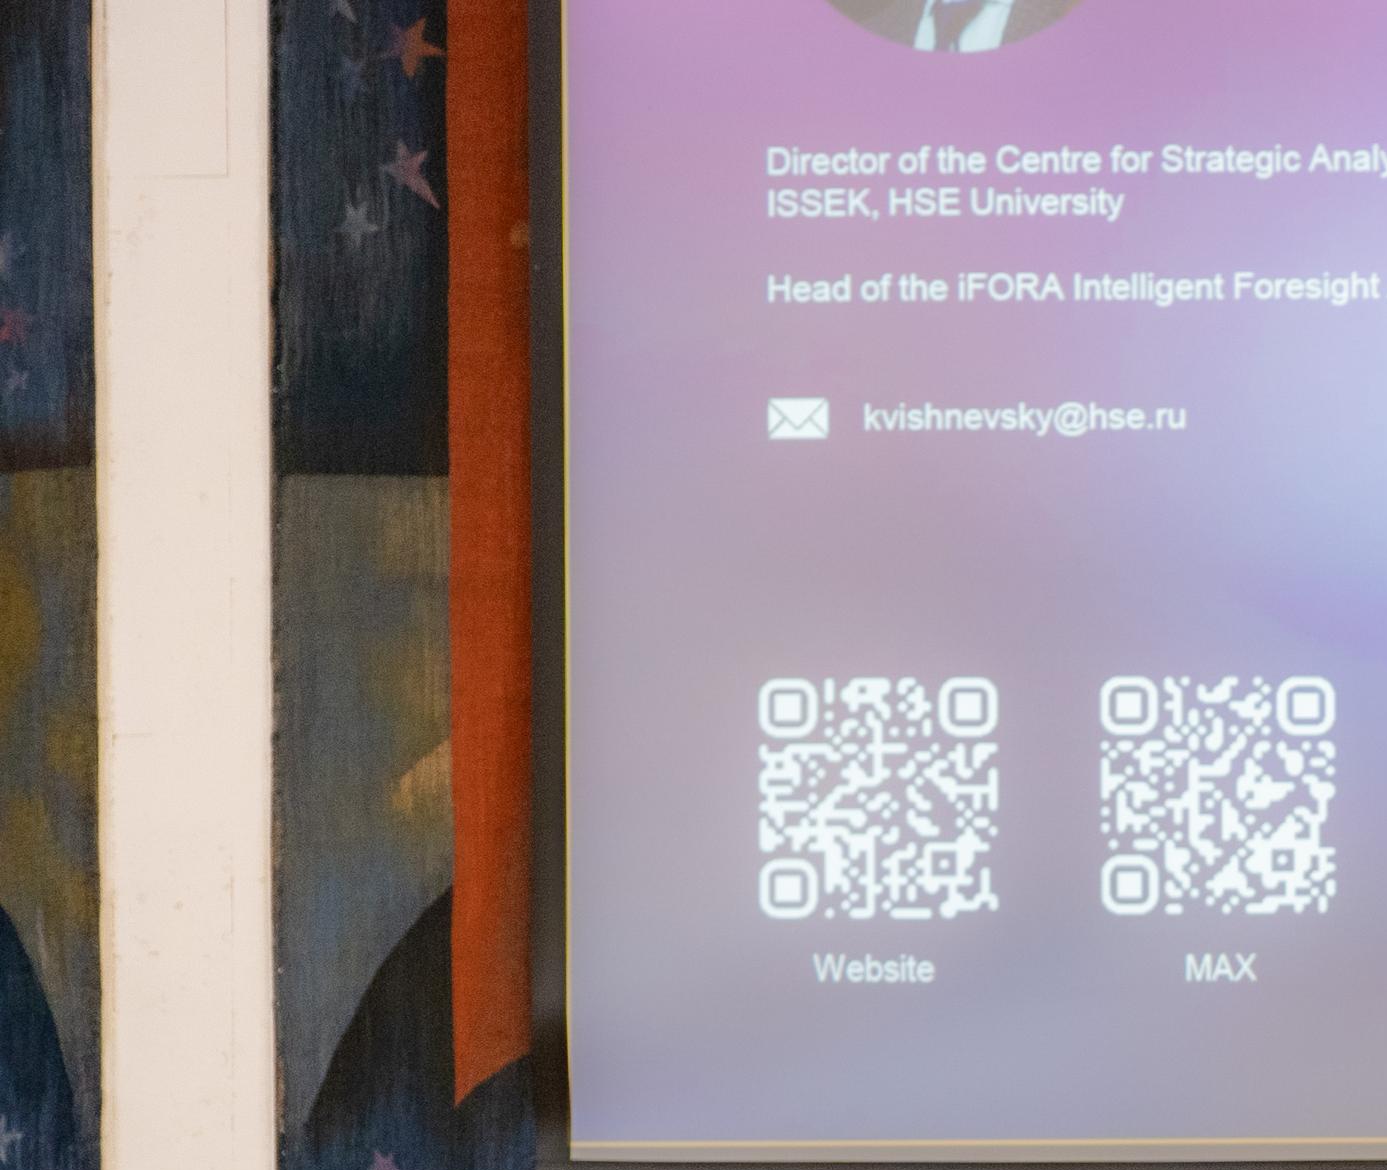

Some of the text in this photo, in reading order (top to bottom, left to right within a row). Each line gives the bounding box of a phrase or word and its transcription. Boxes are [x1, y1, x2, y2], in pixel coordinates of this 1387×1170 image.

[767, 146, 891, 176] Director
[898, 145, 931, 175] of
[936, 145, 987, 174] the
[995, 144, 1102, 174] Centre
[1109, 144, 1153, 174] for
[1161, 144, 1301, 180] Strategic
[768, 187, 1125, 221] ISSEK, HSE University
[768, 274, 852, 303] Head
[860, 273, 893, 302] of
[898, 273, 949, 302] the
[958, 272, 1065, 301] iFORA
[1074, 272, 1224, 307] Intelligent
[1234, 272, 1380, 306] Foresight
[864, 402, 1186, 437] kvishnevsky@hse.ru
[813, 954, 935, 983] Website
[1186, 953, 1257, 981] MAX
